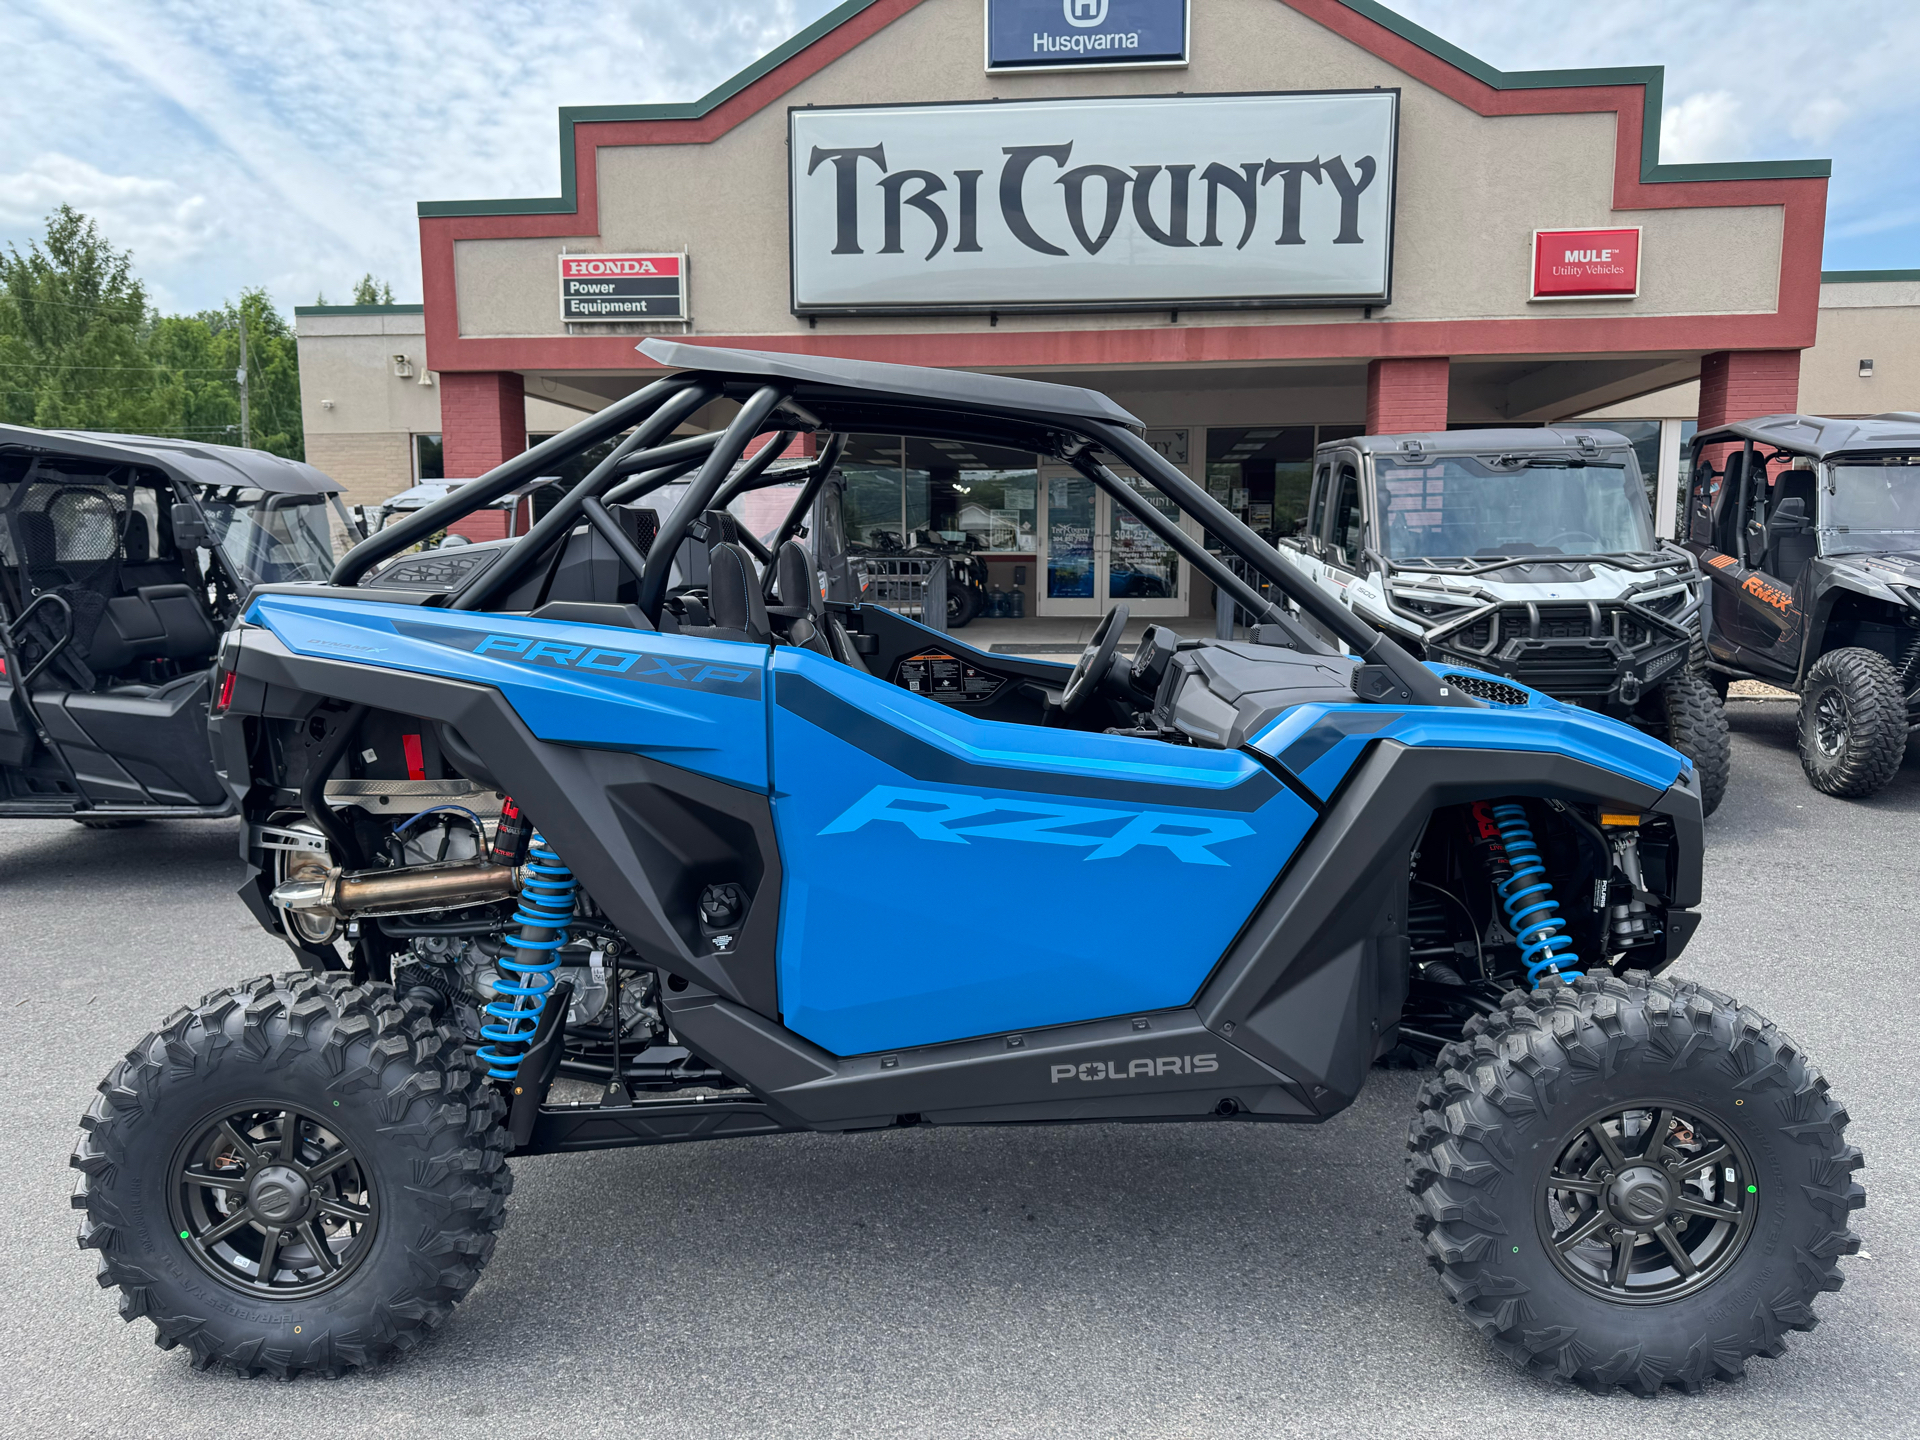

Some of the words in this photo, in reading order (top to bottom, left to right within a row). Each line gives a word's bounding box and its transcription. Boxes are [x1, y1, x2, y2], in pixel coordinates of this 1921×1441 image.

[1033, 32, 1139, 54] Husqvarna
[569, 261, 658, 274] HONDA
[1552, 266, 1582, 277] Utility
[1586, 265, 1624, 275] Vehicles
[569, 282, 615, 293] Power
[570, 300, 647, 314] Equipment
[1115, 529, 1159, 540] 304-257-4
[1356, 586, 1377, 600] 1500
[1741, 576, 1793, 613] RMAX
[307, 638, 390, 653] DYNAMIX
[472, 634, 643, 673] PRO
[636, 657, 753, 683] XP
[816, 784, 1257, 867] RZR
[1051, 1053, 1219, 1083] POLARIS
